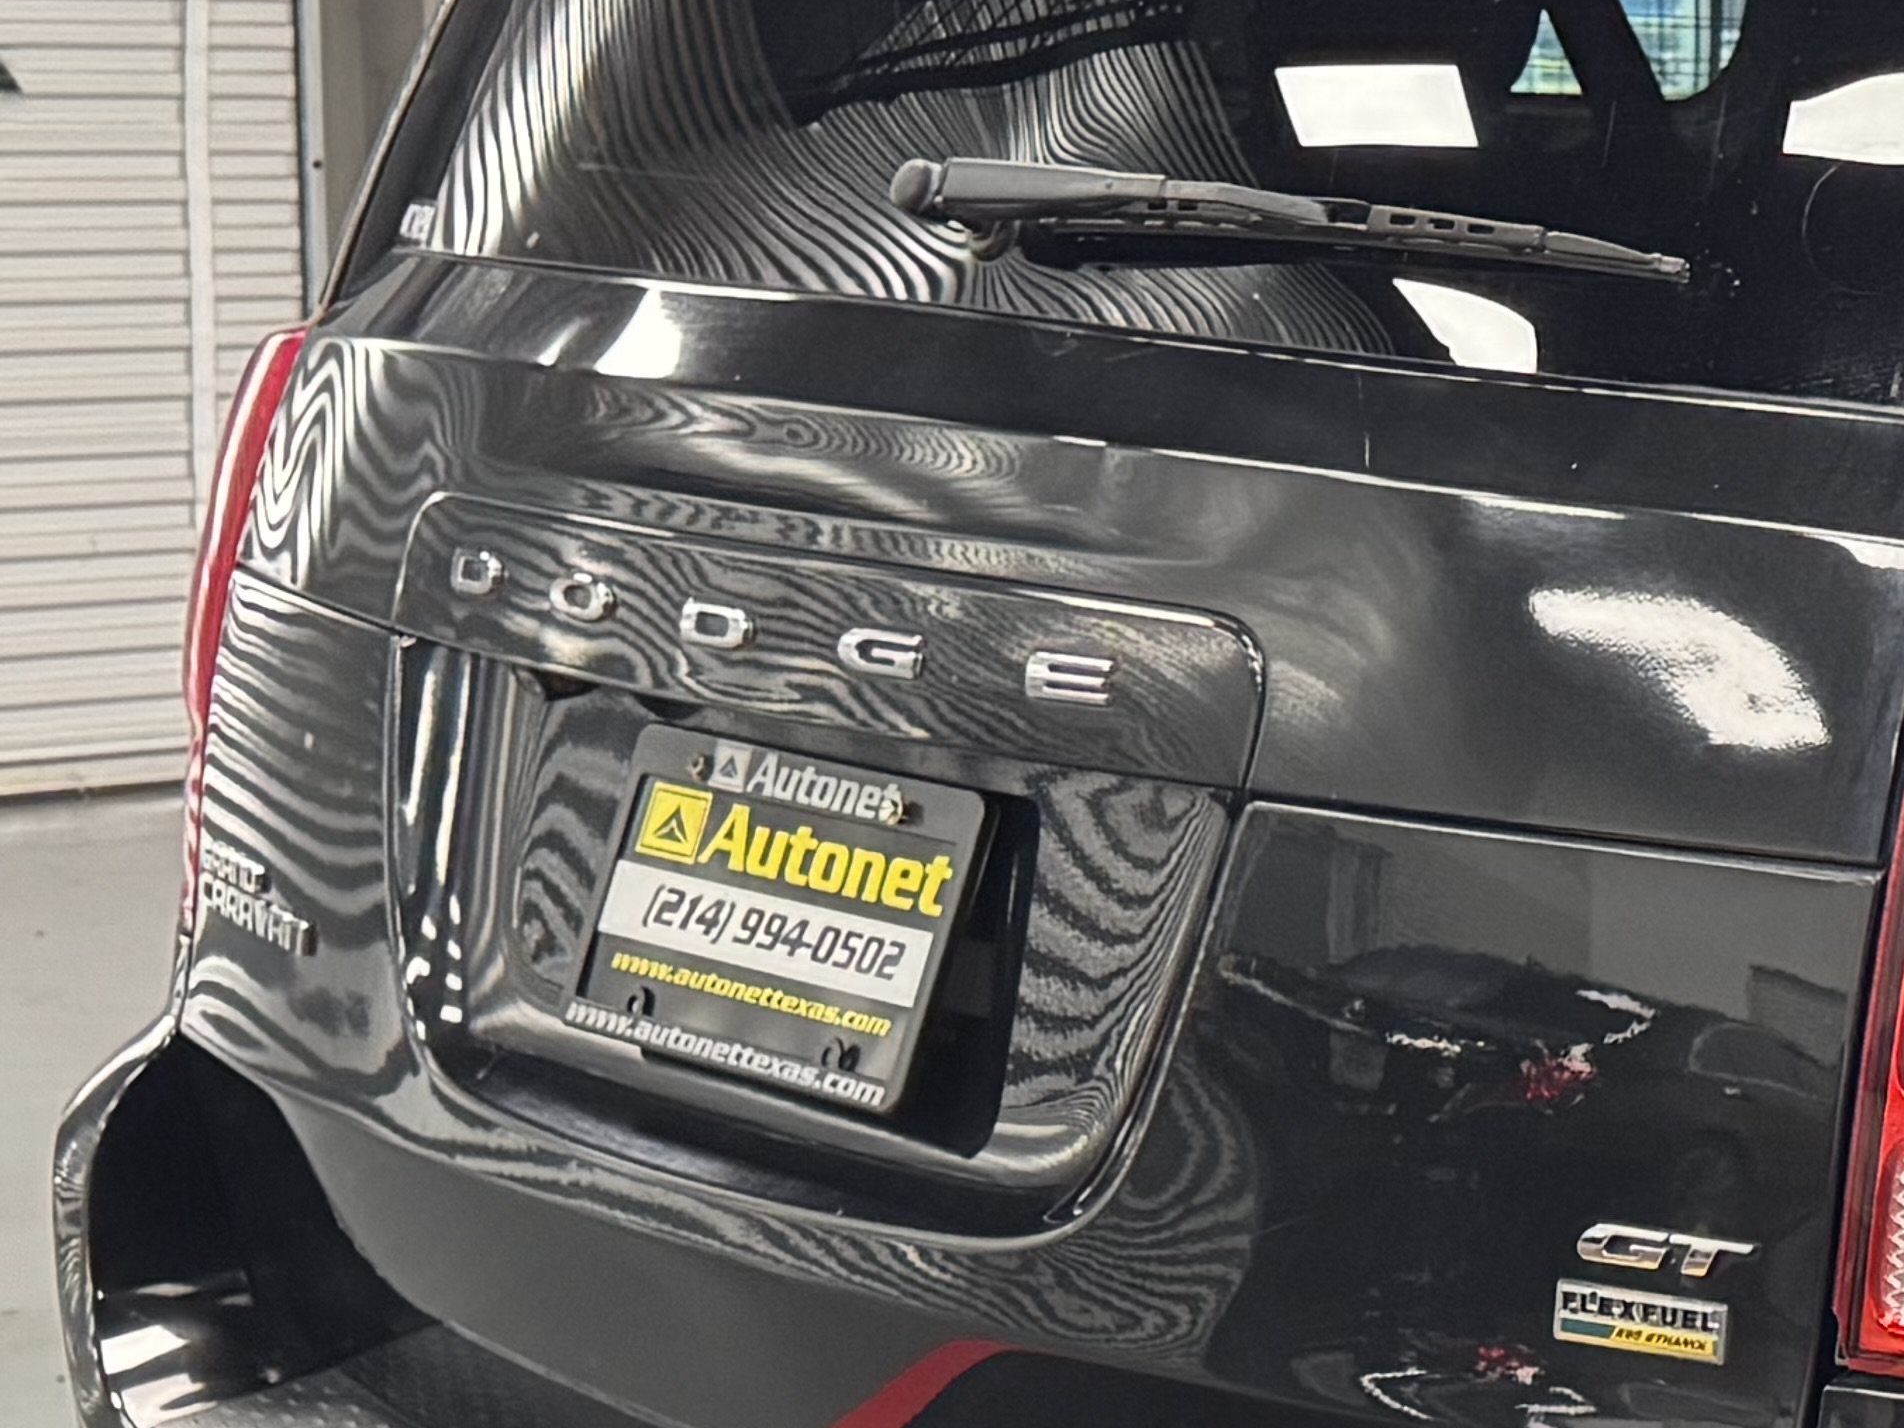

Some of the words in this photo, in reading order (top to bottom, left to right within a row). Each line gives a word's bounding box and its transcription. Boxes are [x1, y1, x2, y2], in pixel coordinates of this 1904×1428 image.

[452, 544, 1118, 708] DODGE
[747, 754, 902, 824] Autonet
[697, 803, 953, 917] Autonet
[643, 883, 735, 944] (214)
[732, 908, 906, 980] 994-0502
[611, 952, 892, 1037] www.autonettexas.com
[565, 1002, 885, 1106] www.autonettexas.com
[1577, 1223, 1756, 1277] GT
